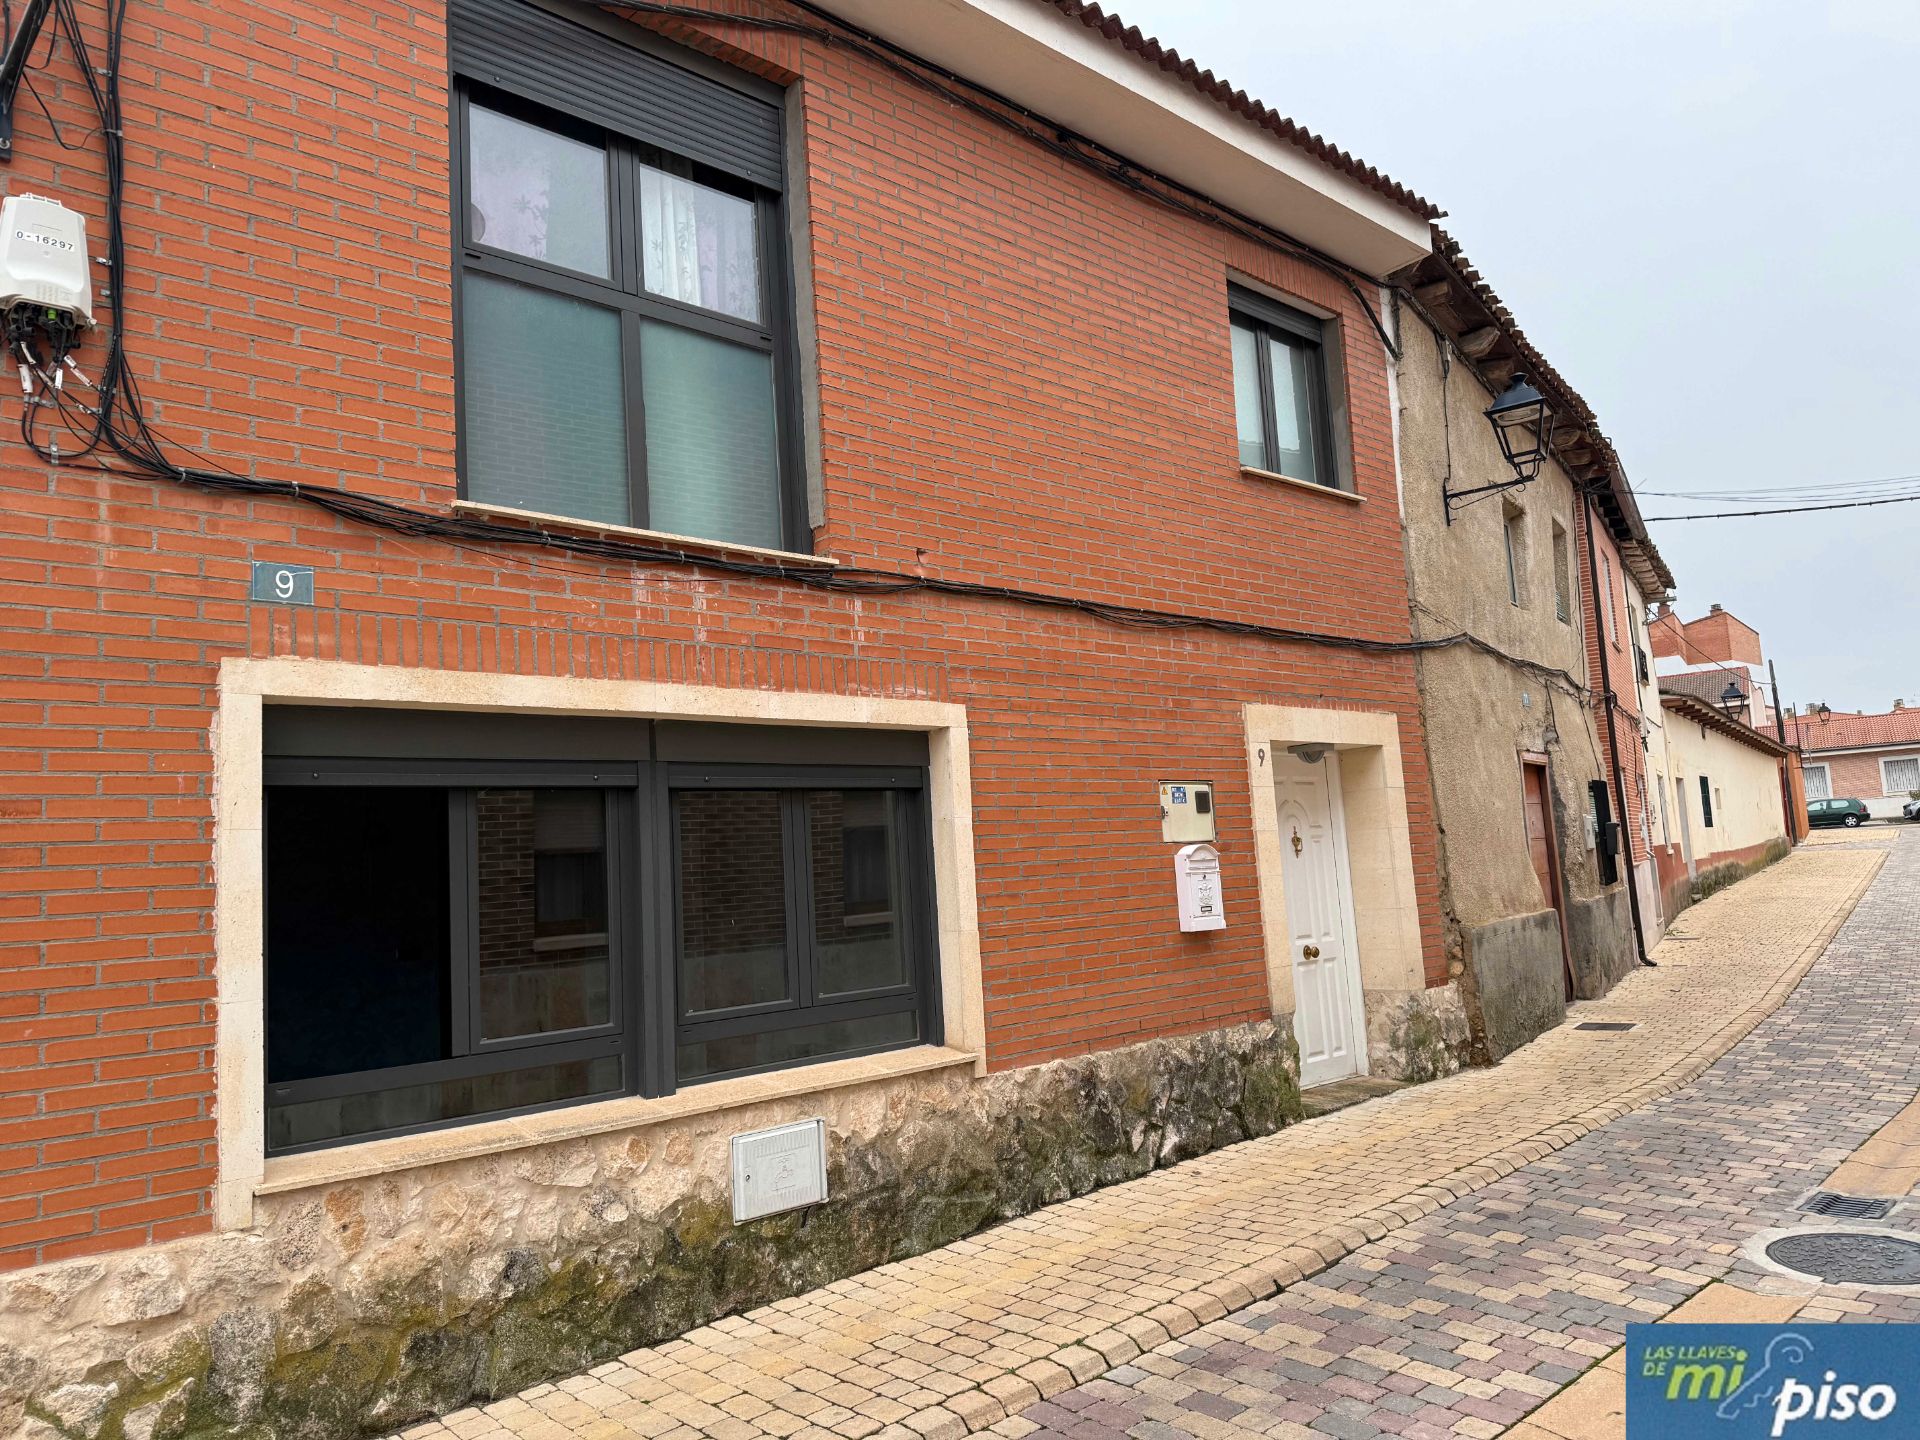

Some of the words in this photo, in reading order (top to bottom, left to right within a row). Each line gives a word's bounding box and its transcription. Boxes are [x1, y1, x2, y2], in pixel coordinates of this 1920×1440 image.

[16, 231, 73, 251] 0-16297
[276, 570, 293, 598] 9
[1258, 748, 1265, 767] 9
